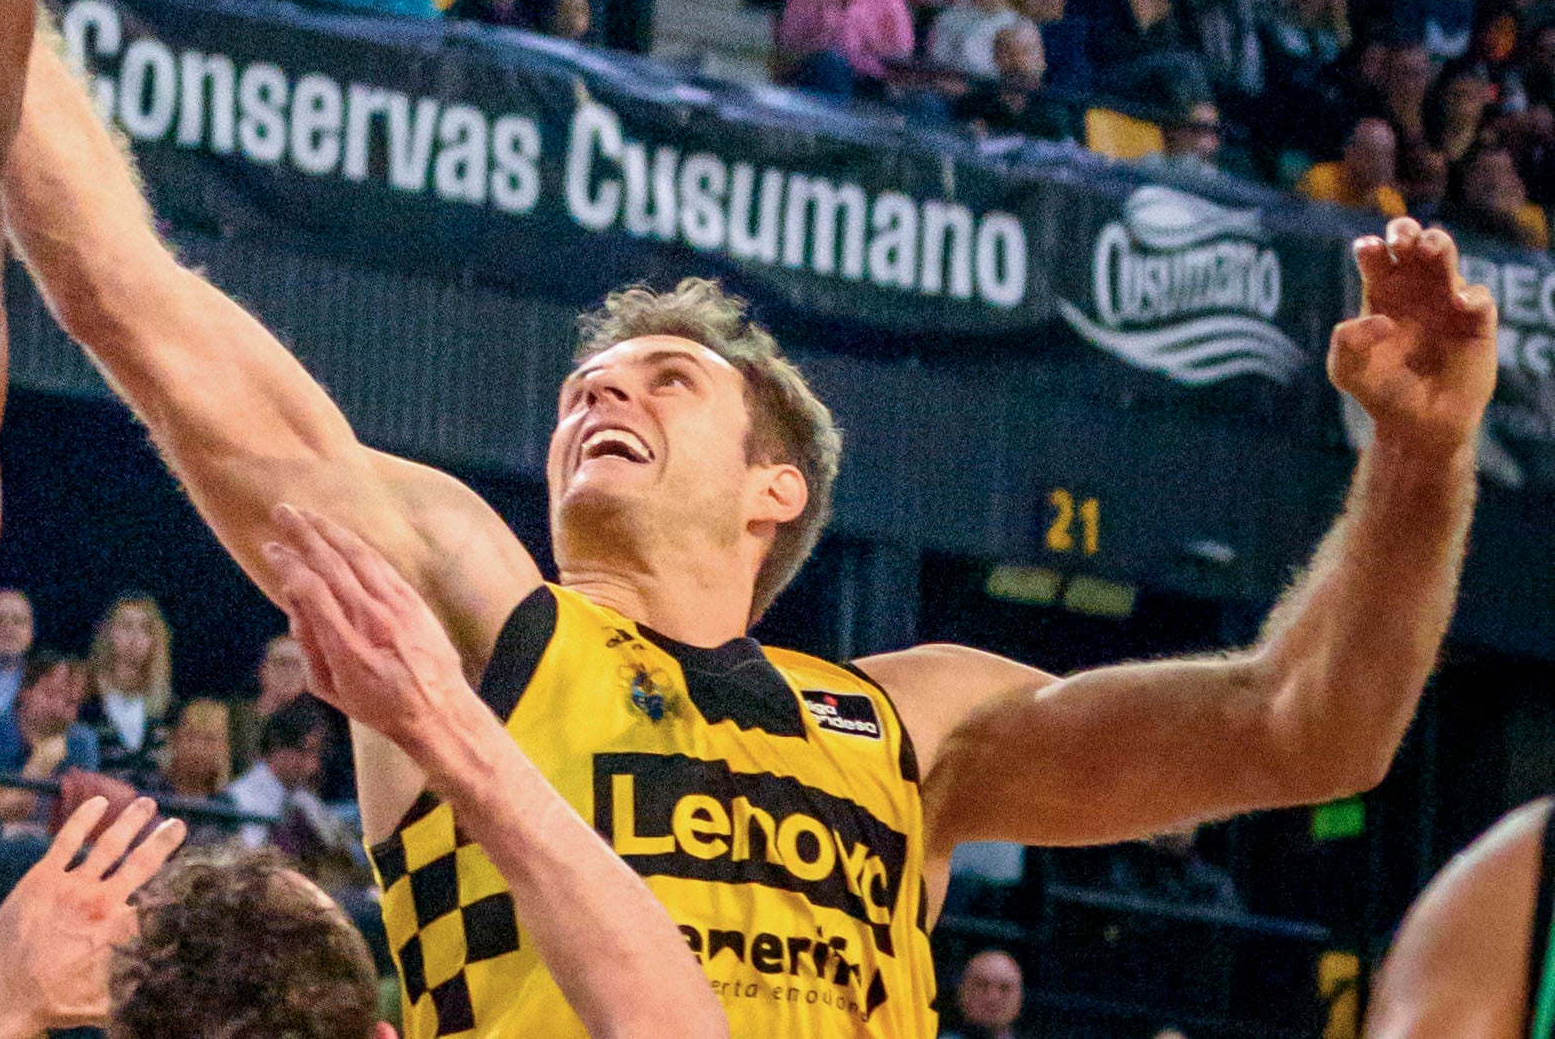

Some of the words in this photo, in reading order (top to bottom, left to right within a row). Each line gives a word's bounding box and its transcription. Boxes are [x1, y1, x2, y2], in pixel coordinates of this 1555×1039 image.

[566, 104, 1027, 308] Cusumano
[1046, 488, 1100, 556] 21
[817, 714, 878, 735] ndesa
